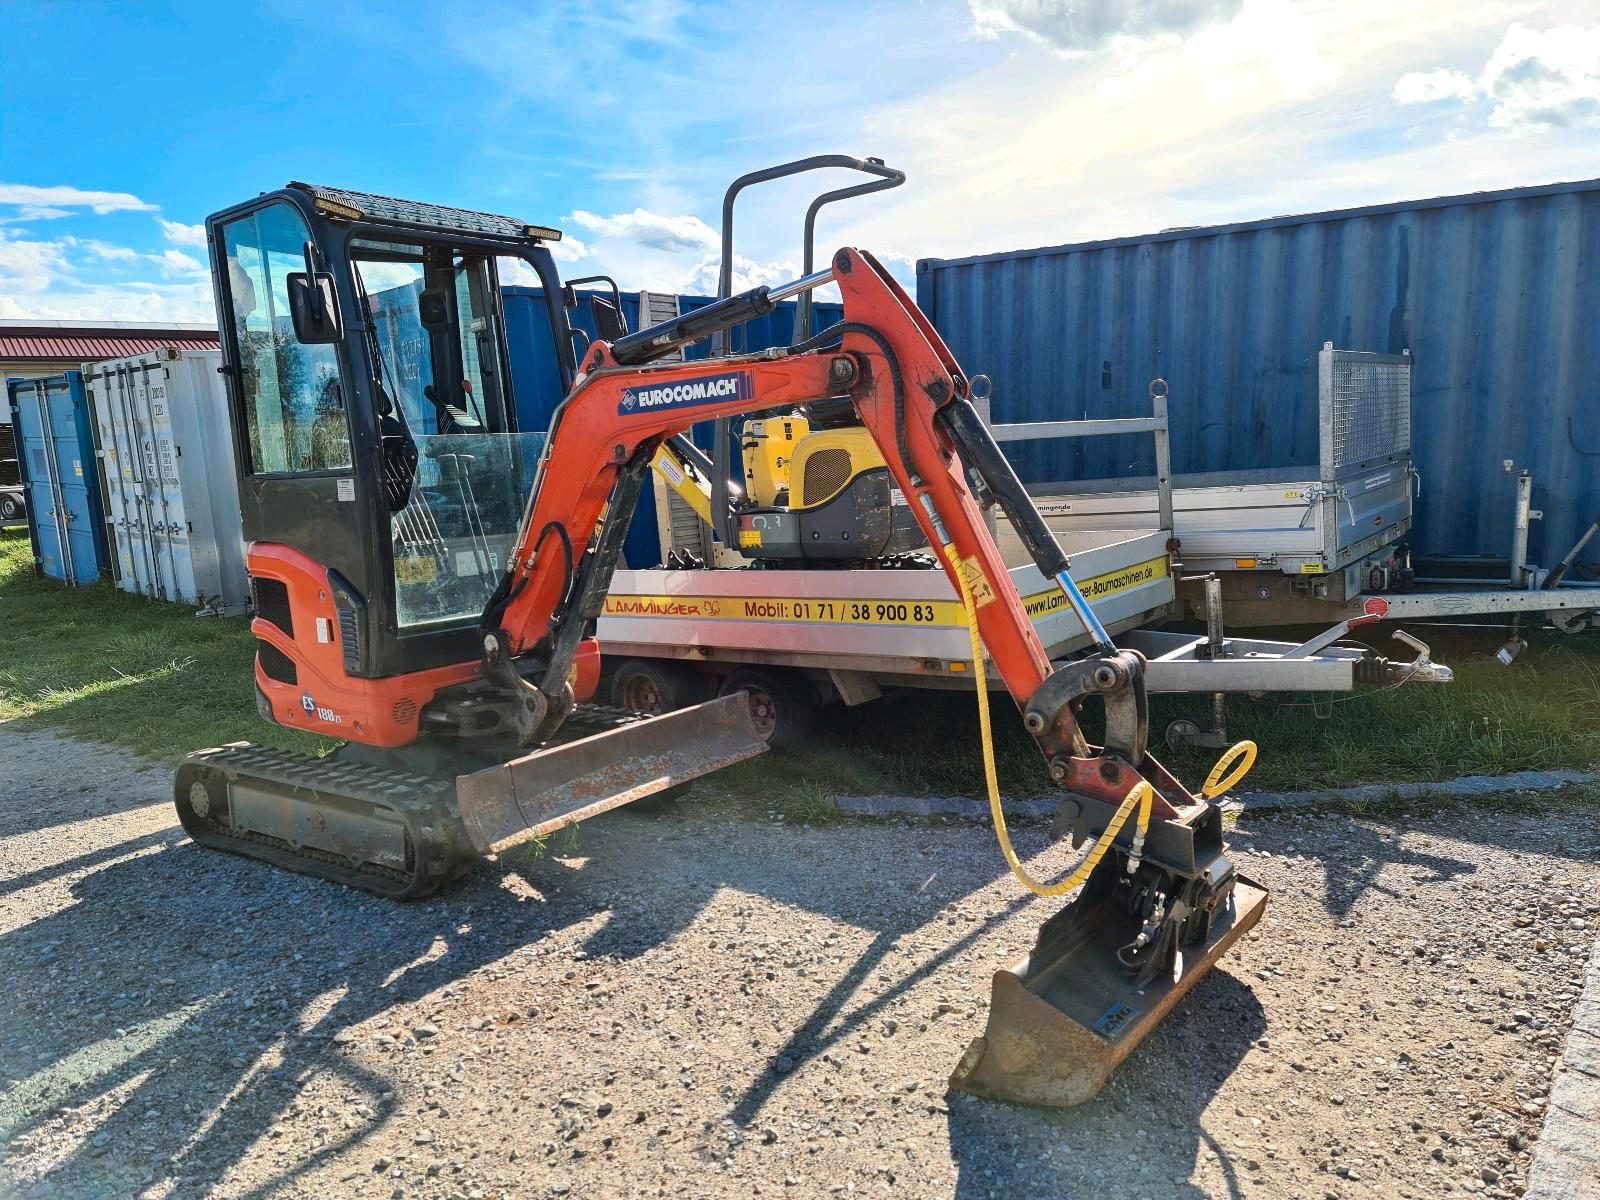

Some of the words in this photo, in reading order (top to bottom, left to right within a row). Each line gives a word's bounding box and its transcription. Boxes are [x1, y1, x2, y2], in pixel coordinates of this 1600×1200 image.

[638, 378, 737, 407] EUROCOMACH
[605, 598, 701, 616] LAMMINGER
[744, 601, 788, 618] Mobil:
[793, 603, 810, 618] 01
[817, 603, 834, 619] 71
[851, 604, 870, 620] 38
[876, 604, 907, 621] 900
[913, 605, 934, 621] 83
[302, 696, 314, 710] ES
[317, 707, 334, 721] 180
